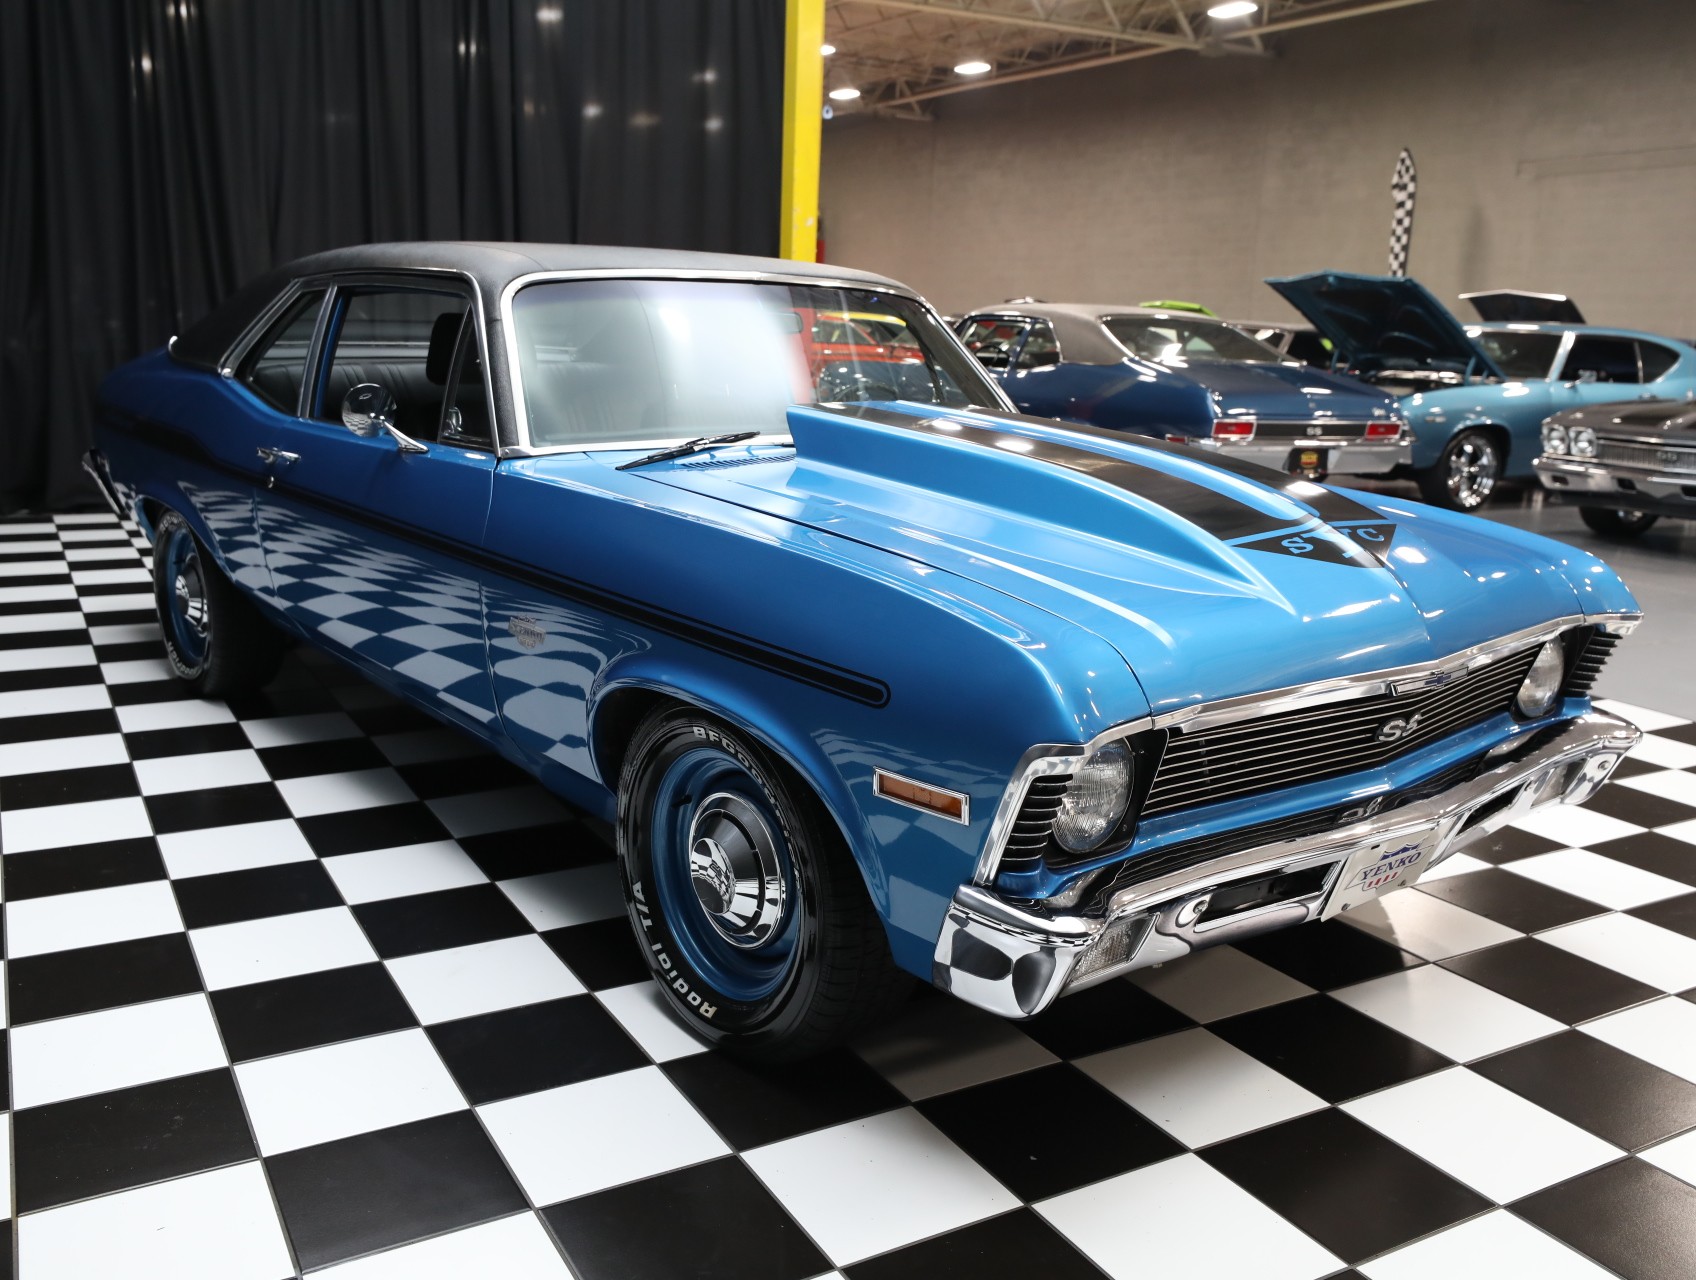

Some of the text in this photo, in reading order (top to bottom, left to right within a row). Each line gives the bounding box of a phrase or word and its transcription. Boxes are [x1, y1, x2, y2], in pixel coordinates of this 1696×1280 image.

[1379, 714, 1421, 741] SS
[1361, 851, 1422, 881] YENKO
[632, 880, 718, 1019] Radial T/A
